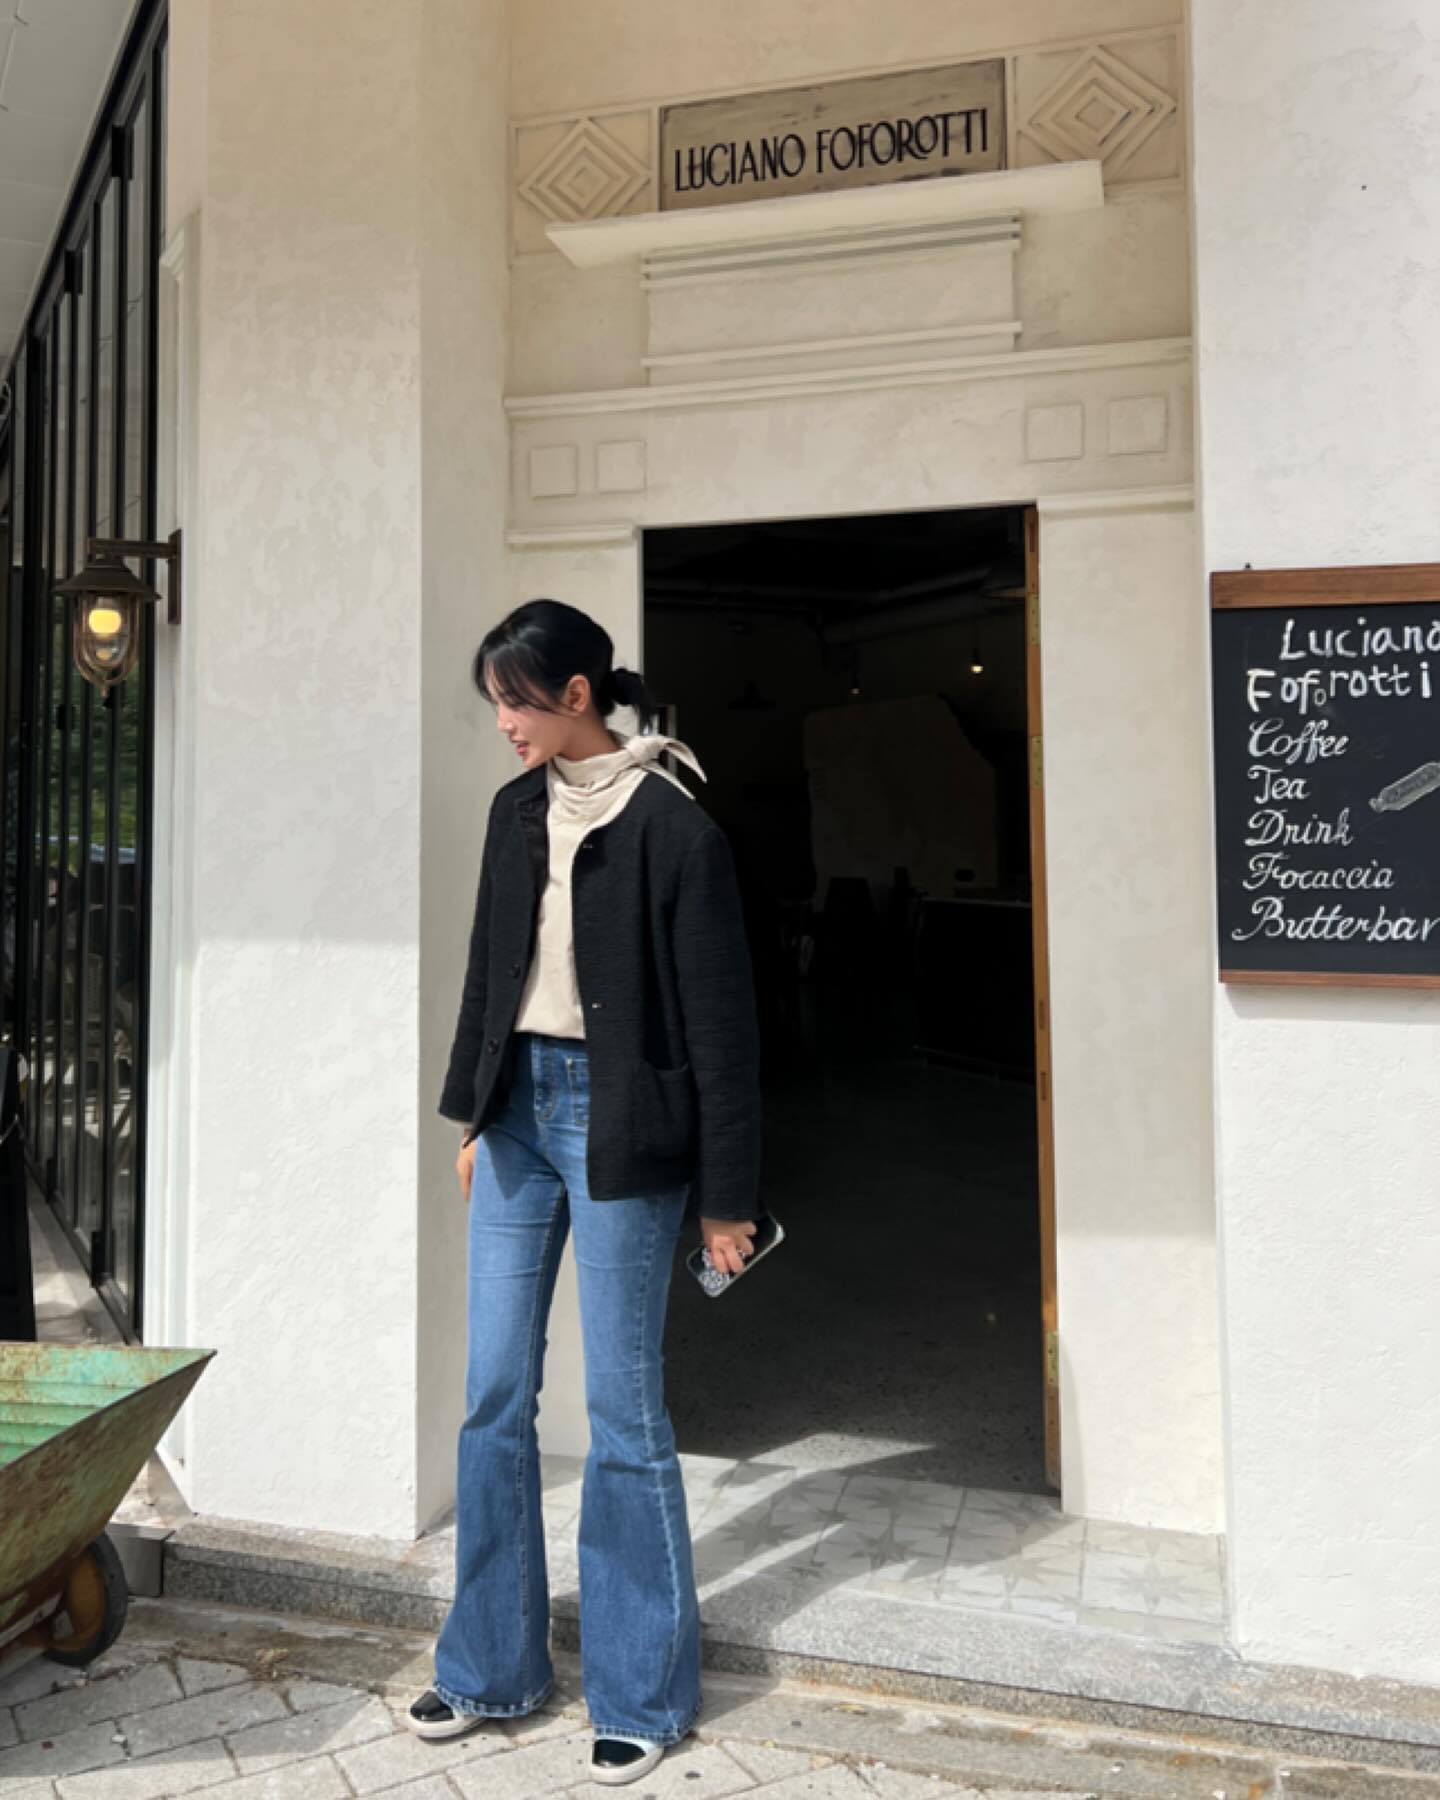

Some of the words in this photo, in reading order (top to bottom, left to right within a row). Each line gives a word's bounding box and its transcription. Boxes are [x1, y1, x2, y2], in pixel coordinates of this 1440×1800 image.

[674, 133, 806, 192] LUCIANO
[815, 107, 988, 174] FOFOROTTI
[1279, 616, 1440, 660] Luciano
[1246, 661, 1431, 714] Foforotti
[1247, 718, 1349, 764] Coffee
[1247, 765, 1311, 804] Tea
[1244, 807, 1353, 846] Drink
[1242, 852, 1394, 890] Focaccia
[1231, 896, 1440, 942] Butterbar
